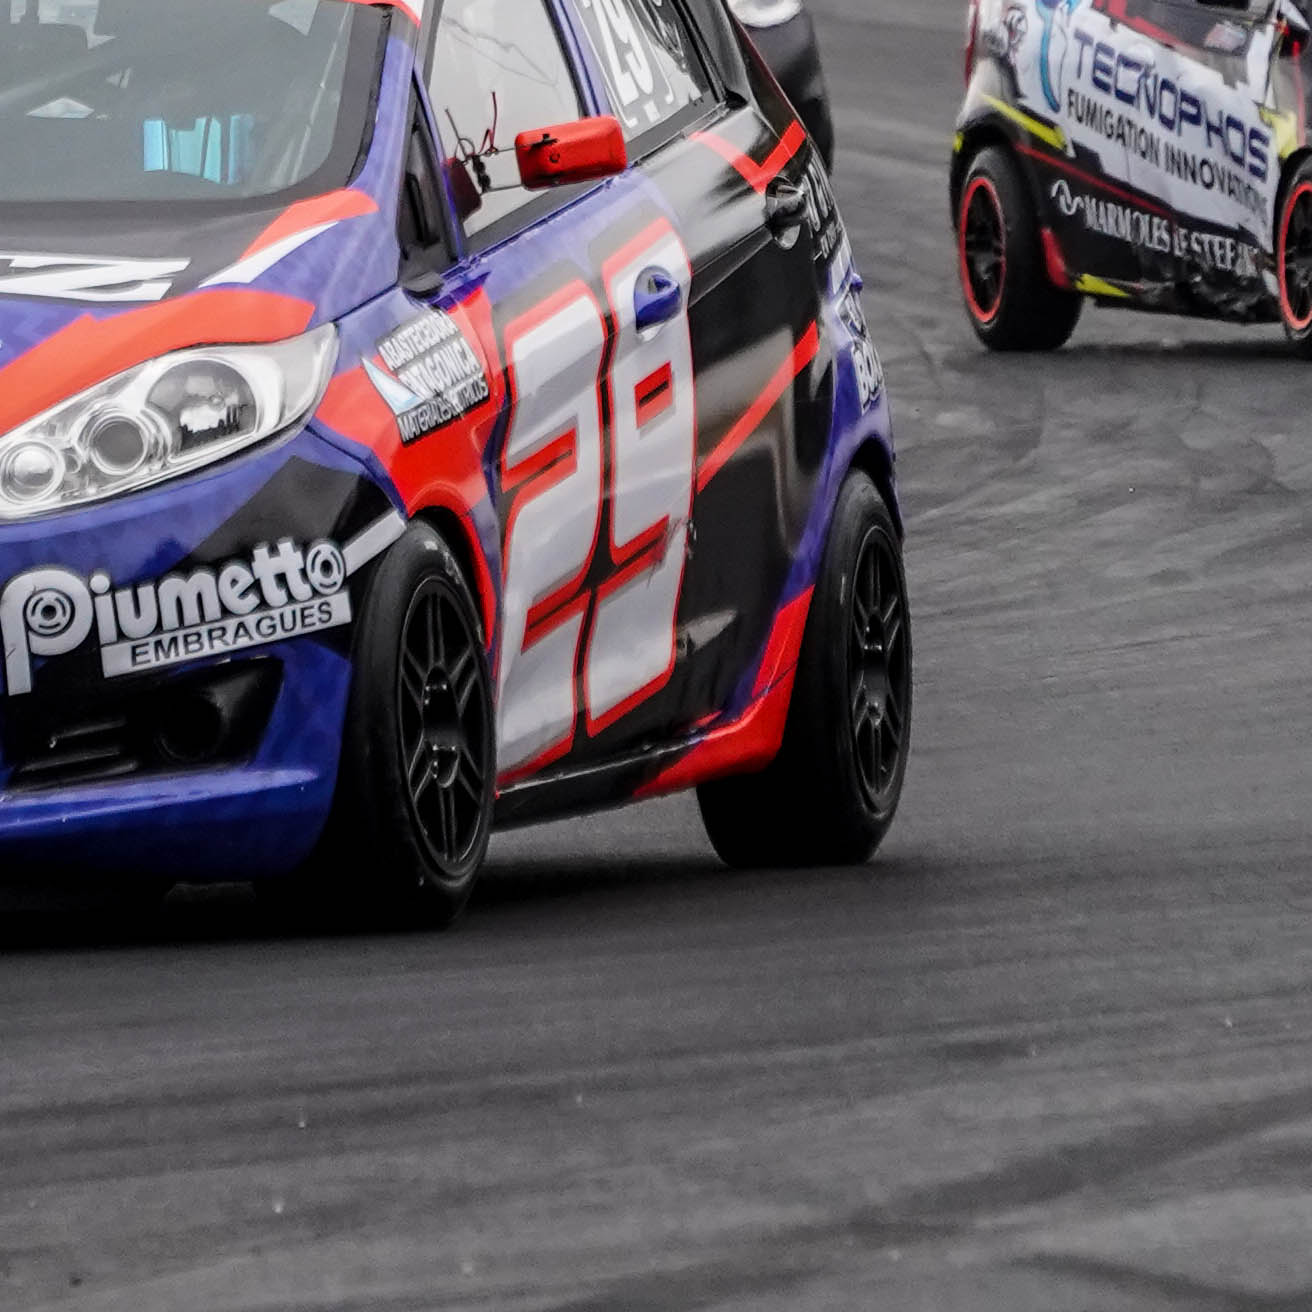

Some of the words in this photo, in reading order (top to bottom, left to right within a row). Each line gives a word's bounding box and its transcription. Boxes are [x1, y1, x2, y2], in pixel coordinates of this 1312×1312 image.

[1067, 88, 1160, 167] FUMIGATION
[1073, 28, 1270, 184] TECNOPHOS
[496, 217, 697, 788] 29
[130, 600, 334, 668] EMBRAGUES
